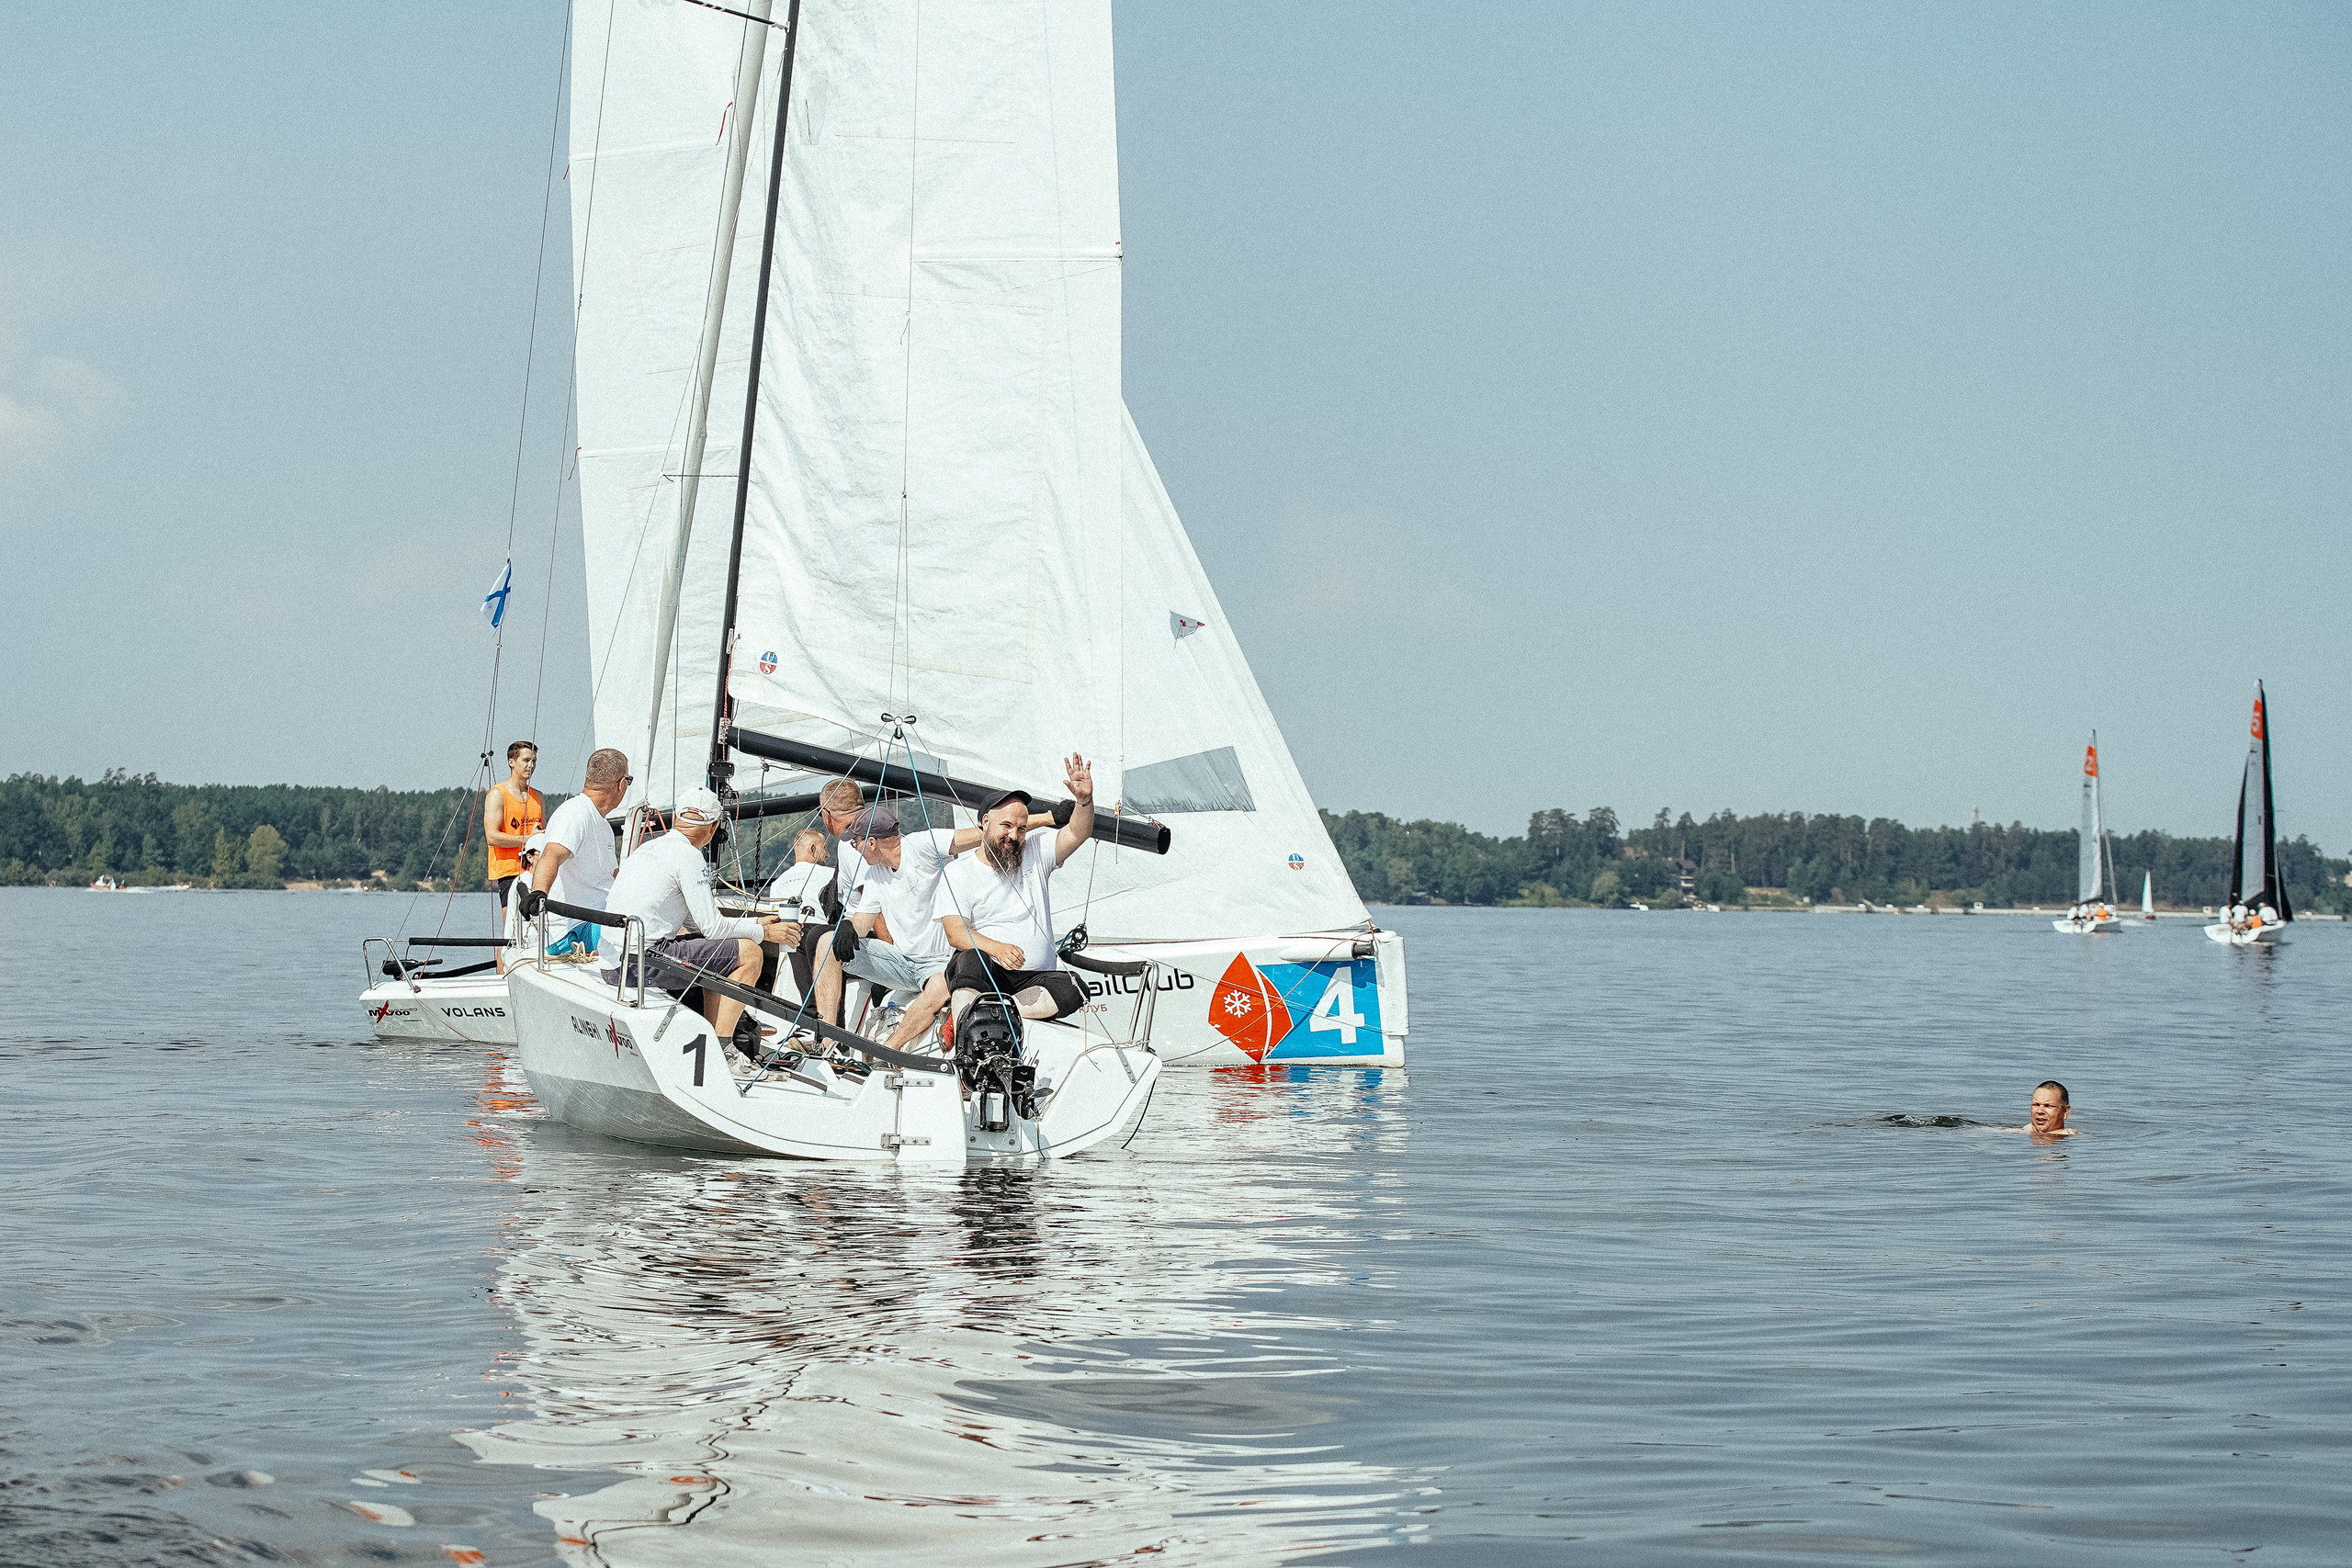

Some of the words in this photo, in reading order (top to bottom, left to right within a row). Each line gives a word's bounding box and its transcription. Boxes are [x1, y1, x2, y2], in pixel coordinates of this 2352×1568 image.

[440, 1007, 506, 1018] VOLANS
[1309, 966, 1365, 1044] 4
[683, 1033, 707, 1087] 1
